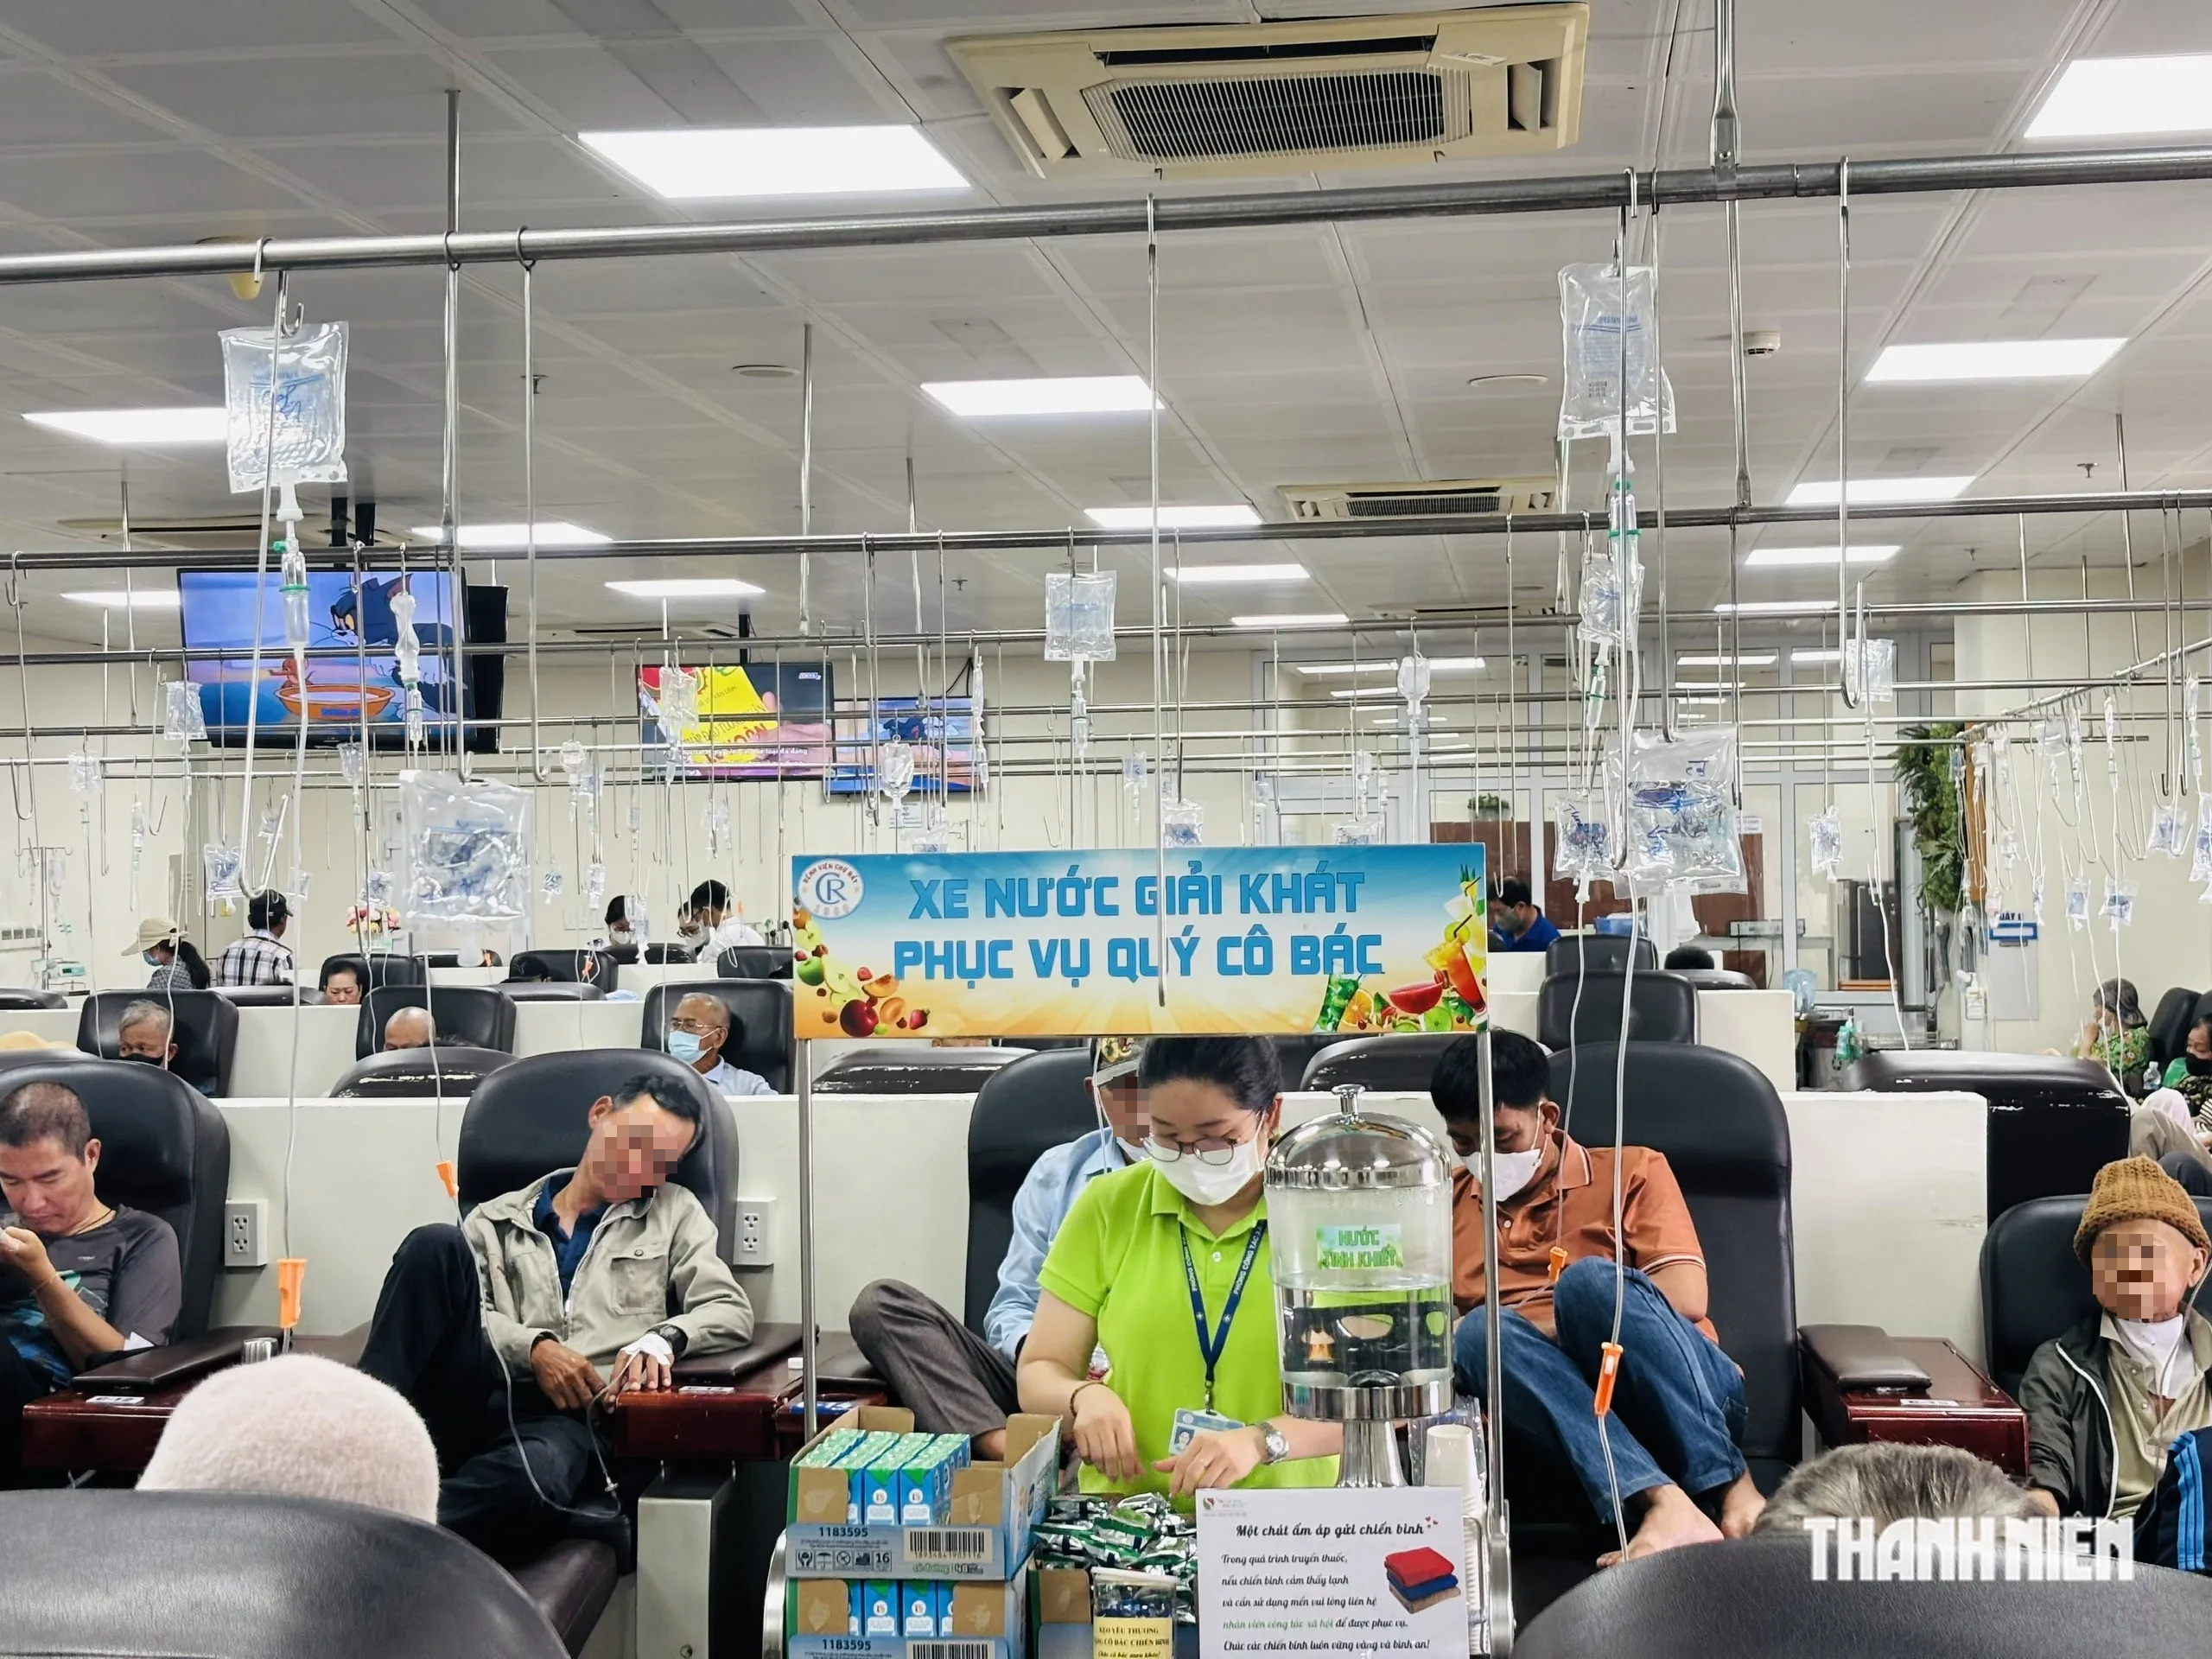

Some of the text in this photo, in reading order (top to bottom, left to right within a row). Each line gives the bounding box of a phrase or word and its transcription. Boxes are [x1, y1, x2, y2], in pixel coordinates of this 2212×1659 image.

[818, 862, 833, 871] VIỆN
[909, 861, 1365, 919] XE NƯỚC GIẢI KHÁT
[894, 939, 1014, 989] PHỤC
[1027, 938, 1091, 988] VỤ
[1217, 924, 1274, 976] CÔ
[1290, 923, 1382, 975] BÁC
[1338, 1224, 1380, 1246] NƯỚC
[818, 1526, 868, 1537] 1183595
[1236, 1524, 1258, 1538] Một
[1262, 1523, 1289, 1536] chút
[1292, 1522, 1312, 1535] ấm
[1315, 1523, 1331, 1538] áp
[1334, 1523, 1356, 1538] gửi
[1359, 1521, 1393, 1535] chiến
[875, 1552, 890, 1563] 16
[1221, 1554, 1247, 1567] Trong
[1249, 1553, 1266, 1566] quá
[1222, 1573, 1237, 1586] nếu
[1239, 1573, 1262, 1586] chiến
[1306, 1573, 1326, 1587] thấy
[1328, 1574, 1349, 1586] lạnh
[1222, 1597, 1233, 1607] và
[1265, 1598, 1289, 1609] dụng
[1311, 1596, 1325, 1606] vui
[1326, 1595, 1346, 1608] lòng
[1348, 1596, 1364, 1606] liên
[1366, 1595, 1377, 1607] hệ
[1268, 1618, 1288, 1631] công
[1290, 1618, 1303, 1629] tác
[1335, 1616, 1348, 1628] để
[1348, 1618, 1370, 1629] được
[1371, 1618, 1393, 1630] phục
[1395, 1620, 1408, 1629] vụ.
[822, 1638, 871, 1651] 1183595
[1224, 1640, 1245, 1650] Chúc
[1247, 1640, 1262, 1650] các
[1263, 1638, 1287, 1650] chiến
[1310, 1639, 1329, 1650] luôn
[1332, 1640, 1354, 1652] vững
[1356, 1639, 1378, 1651] vàng
[1380, 1639, 1390, 1649] và
[1414, 1639, 1430, 1649] an!
